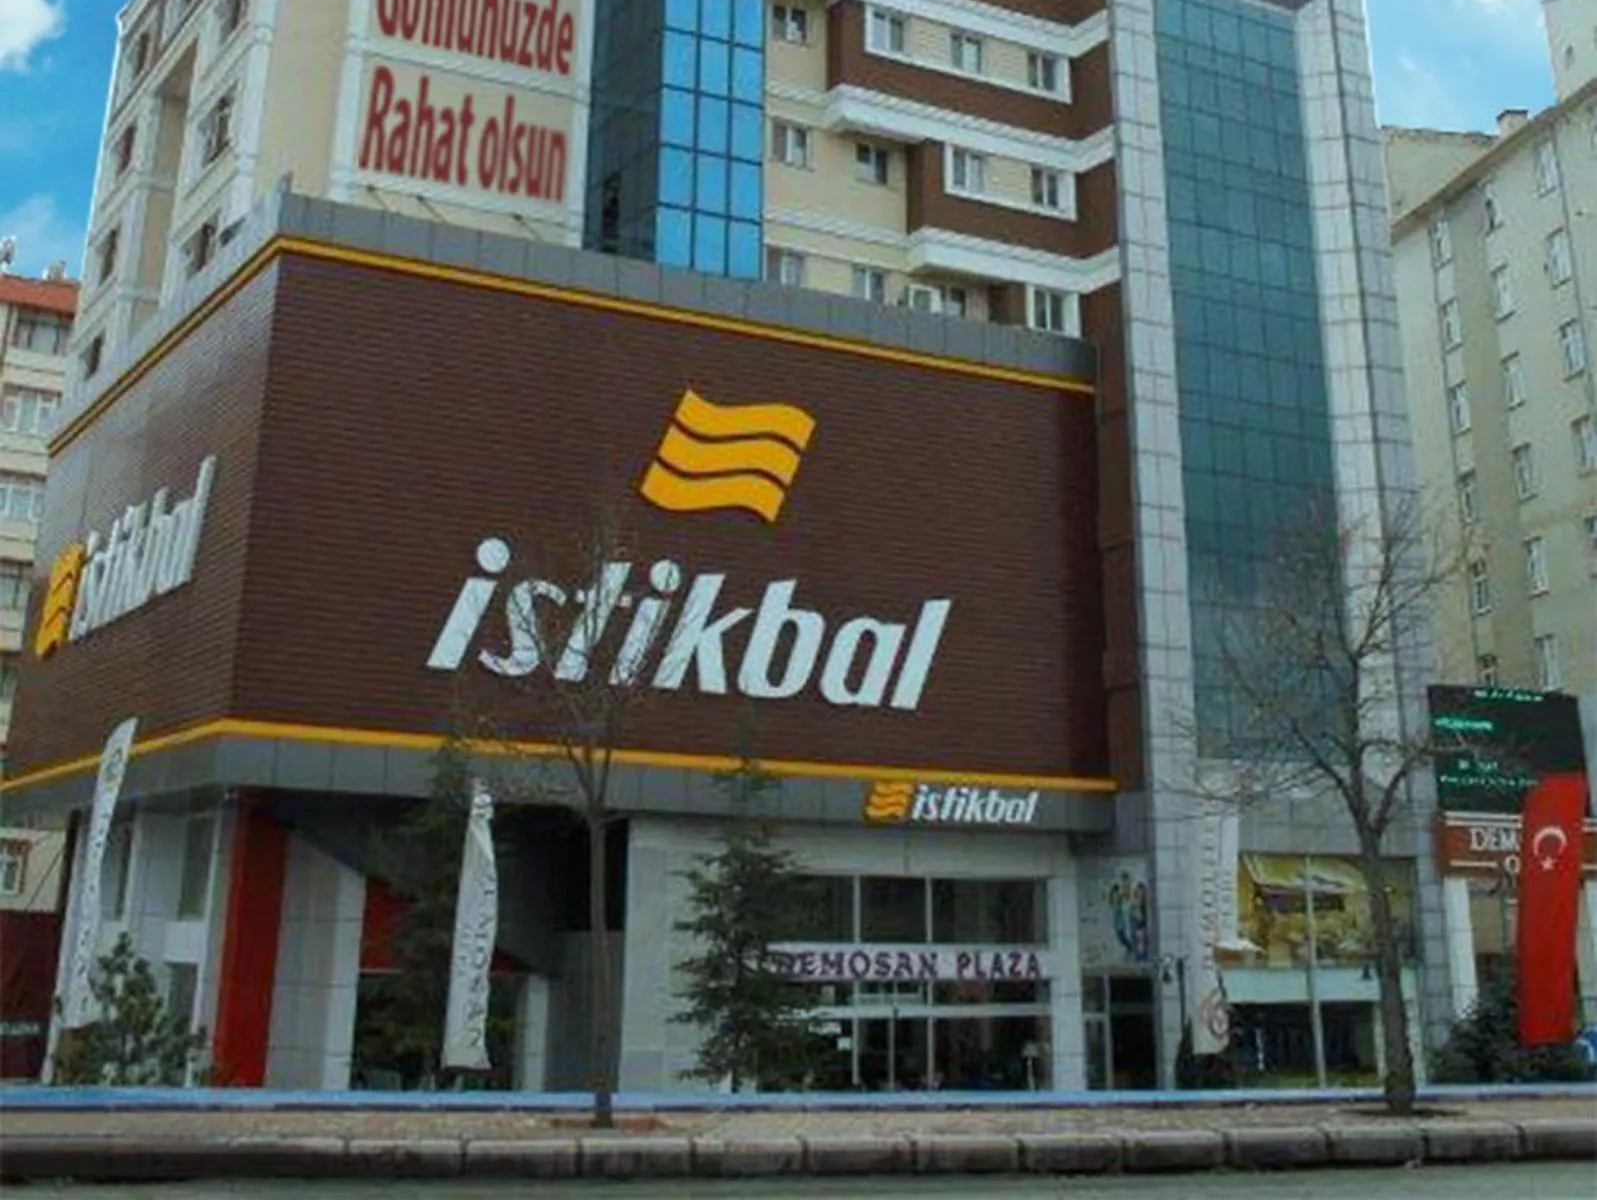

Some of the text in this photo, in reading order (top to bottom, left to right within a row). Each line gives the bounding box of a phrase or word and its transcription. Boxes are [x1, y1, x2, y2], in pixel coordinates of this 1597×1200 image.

[358, 66, 566, 202] Rahat olsun
[426, 537, 952, 711] istikbal
[911, 784, 1040, 824] istikbal
[956, 952, 1042, 978] PLAZA
